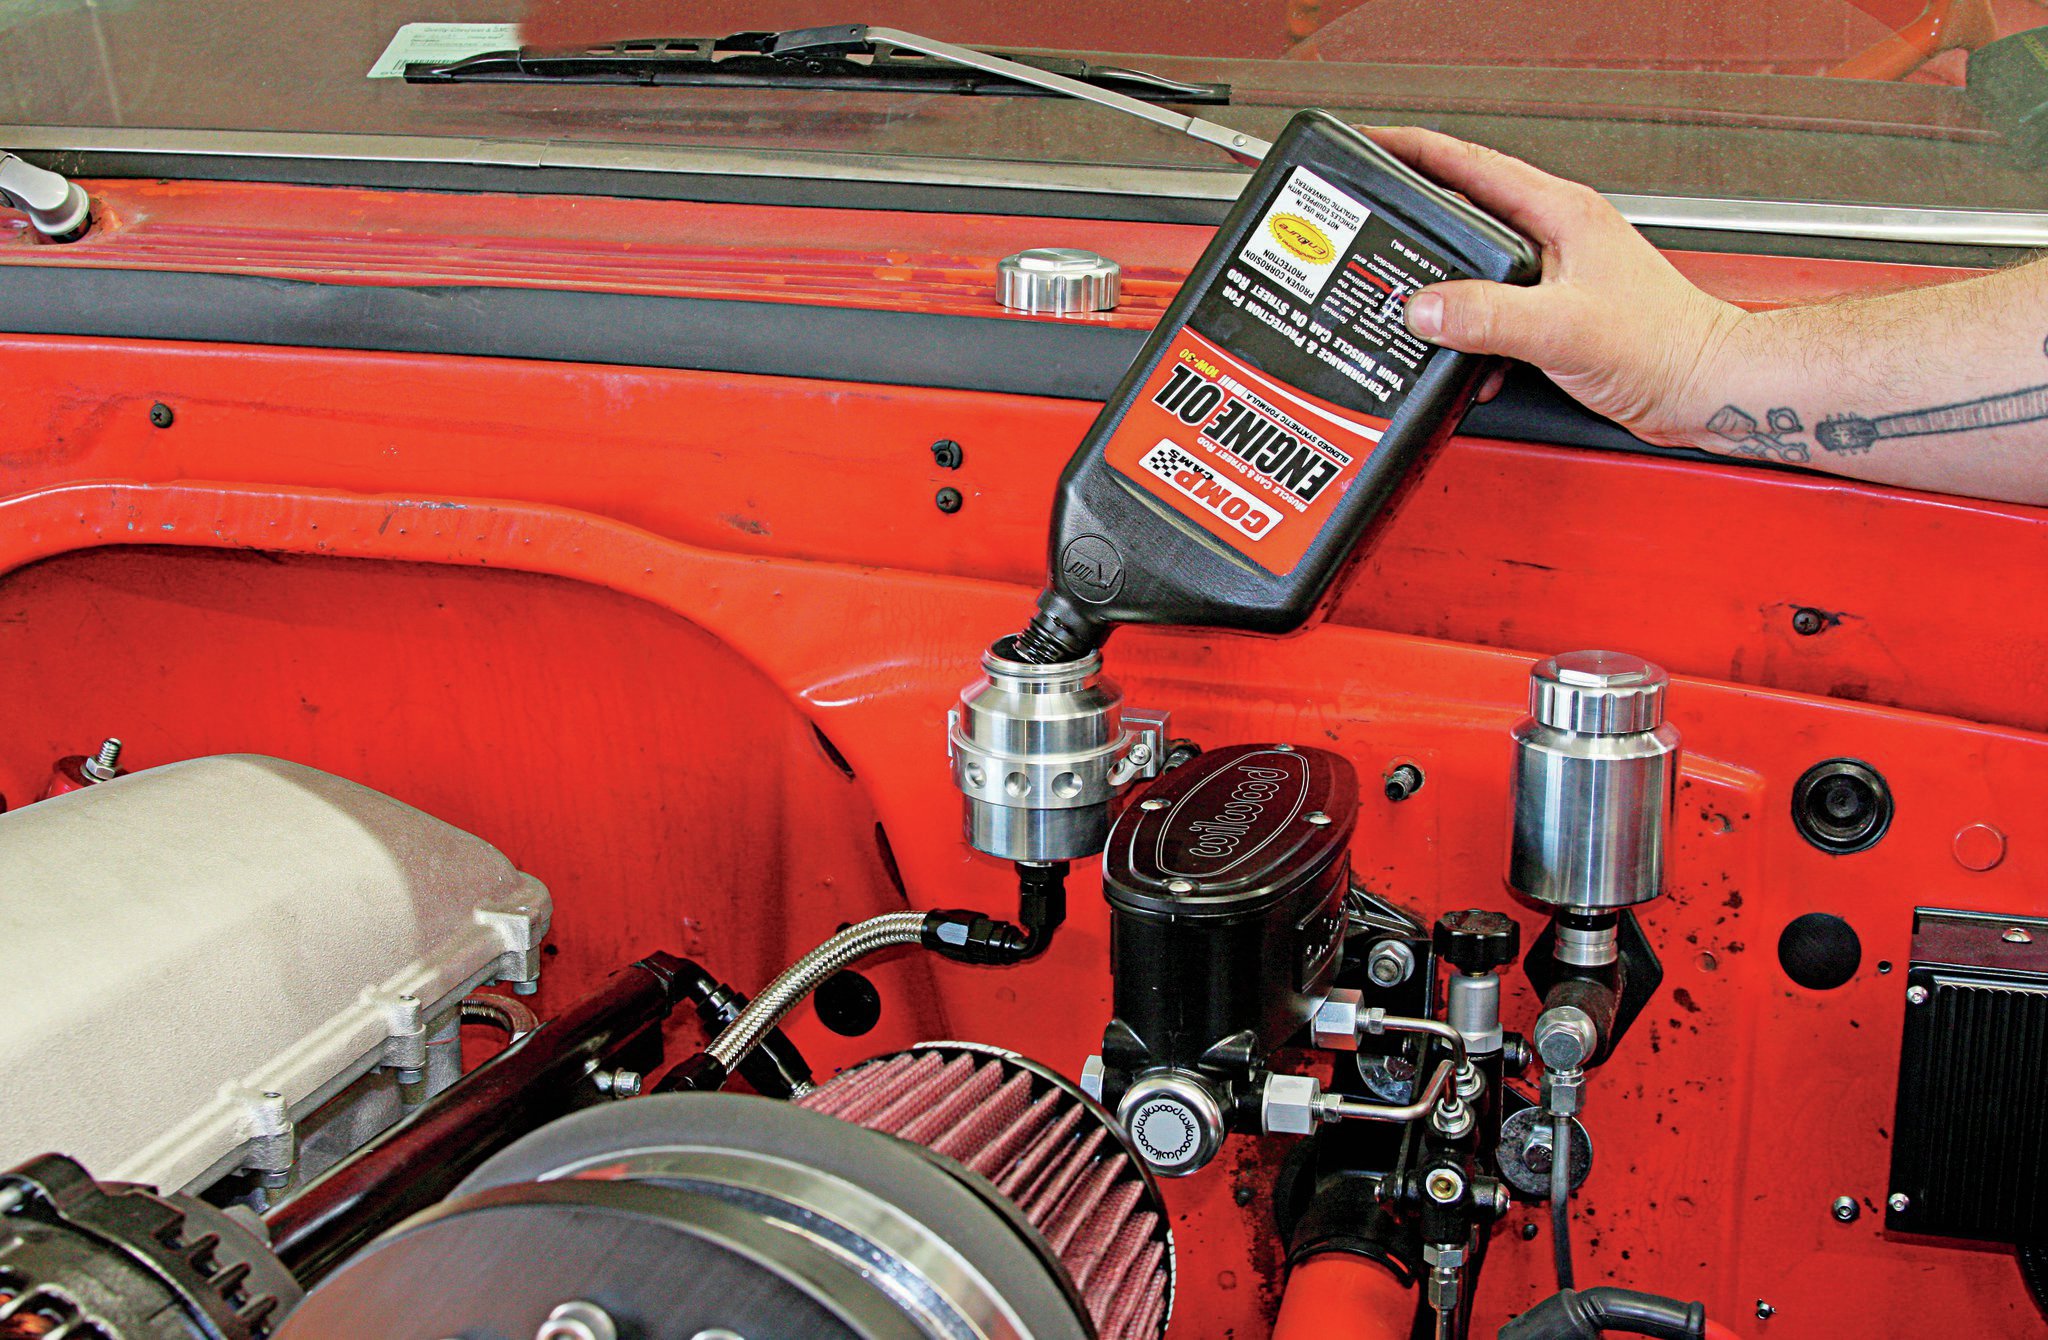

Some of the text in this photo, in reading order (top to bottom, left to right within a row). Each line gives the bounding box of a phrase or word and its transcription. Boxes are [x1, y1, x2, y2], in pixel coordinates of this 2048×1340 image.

[1286, 183, 1357, 231] VEHICLES EQUIPPED WITH
[1293, 177, 1360, 223] CATALYTIC CONVERTERS
[1302, 203, 1315, 214] USE
[1314, 211, 1327, 222] FOR
[1326, 219, 1339, 229] NOT
[1243, 249, 1315, 299] PROVEN CORROSION
[1262, 248, 1307, 281] PROTECTION
[1352, 253, 1367, 265] and
[1370, 251, 1409, 280] protection.
[1427, 264, 1442, 277] U.S.
[1335, 278, 1349, 289] the
[1341, 269, 1374, 293] additives
[1365, 260, 1409, 292] performance
[1349, 286, 1378, 308] contains
[1373, 290, 1384, 300] of
[1319, 302, 1417, 369] Blended synthetic formula
[1324, 295, 1423, 360] prevents corrosion, rust and
[1330, 286, 1428, 352] deterioration during extended
[1178, 347, 1220, 378] 10W-30
[1150, 361, 1343, 505] ENGINE OIL
[1244, 393, 1349, 463] BLENDED SYNTHETIC FORMULA
[1166, 448, 1214, 481] CAMS
[1171, 463, 1271, 536] COMP
[1189, 767, 1289, 857] wilwood
[1137, 1103, 1184, 1126] wilwood
[1133, 1125, 1175, 1161] wilwood
[1174, 1113, 1196, 1161] wilwood
